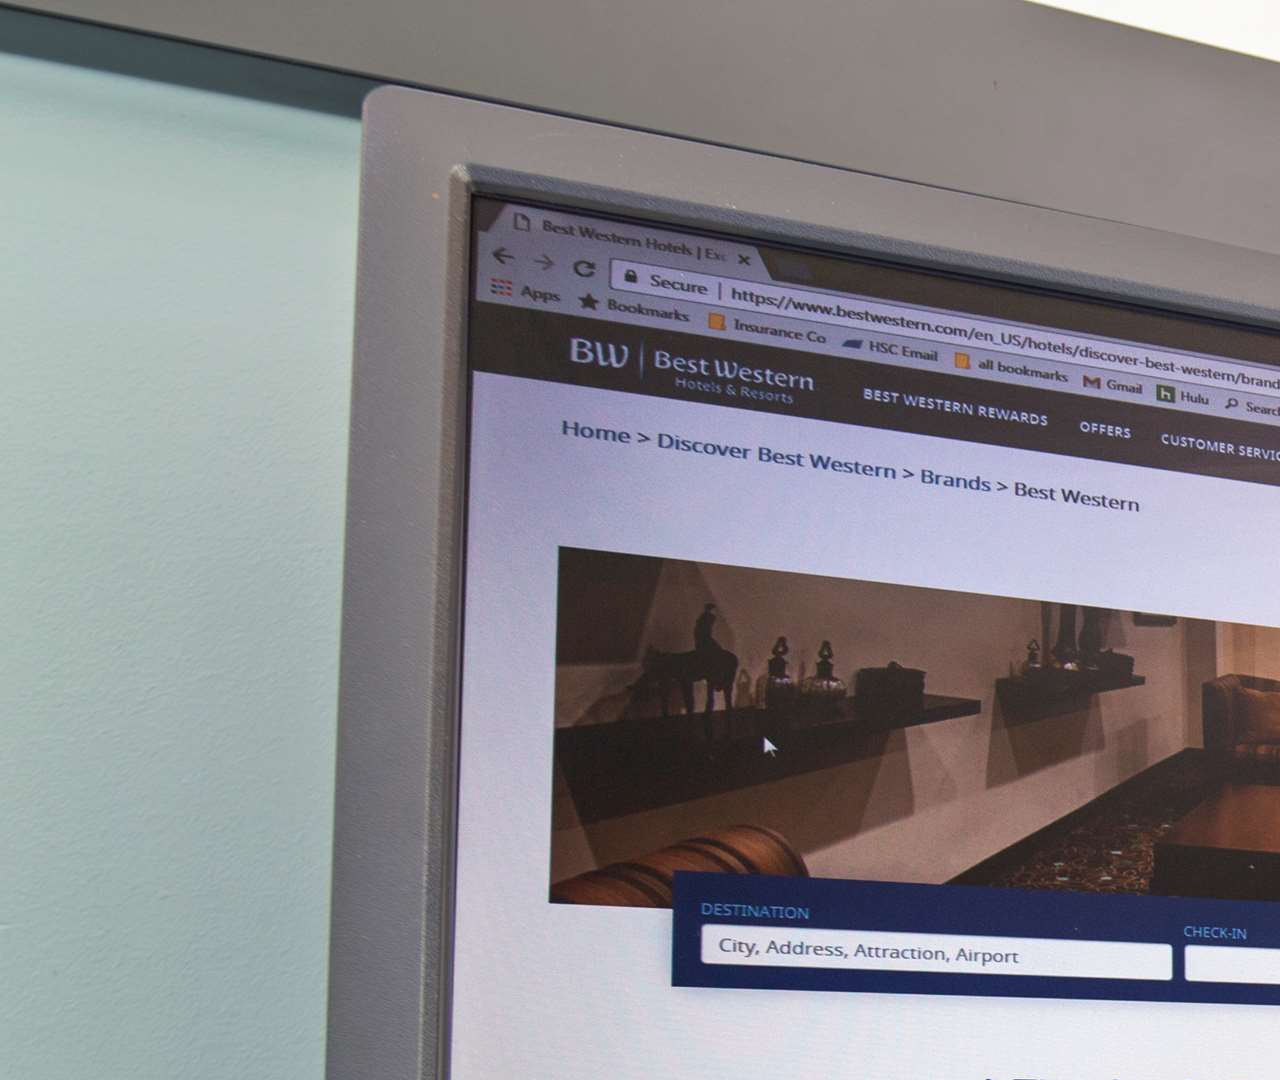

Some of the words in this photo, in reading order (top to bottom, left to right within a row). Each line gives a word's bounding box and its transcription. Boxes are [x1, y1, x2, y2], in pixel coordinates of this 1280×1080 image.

[543, 220, 576, 237] Best
[576, 225, 641, 248] Western
[646, 237, 692, 257] Hotels
[521, 285, 561, 303] Apps
[650, 274, 708, 296] Secure
[607, 298, 690, 322] Bookmarks
[733, 318, 803, 341] Insurance
[807, 331, 827, 345] Co
[570, 337, 630, 369] BW
[869, 340, 899, 356] HSC
[902, 346, 939, 363] Email
[654, 350, 710, 377] Best
[714, 360, 816, 391] Western
[978, 359, 994, 371] all
[997, 361, 1069, 383] bookmarks
[675, 375, 722, 395] Hotels
[726, 384, 737, 396] &
[740, 387, 795, 405] Resorts
[1107, 379, 1143, 396] Gmail
[1180, 390, 1210, 407] Hulu
[863, 388, 900, 404] BEST
[902, 394, 974, 416] WESTERN
[978, 405, 1048, 427] REWARDS
[1079, 420, 1132, 439] OFFERS
[1161, 433, 1235, 455] CUSTOMER
[562, 420, 631, 444] Home
[657, 433, 751, 460] Discover
[758, 447, 805, 467] Best
[809, 454, 896, 479] Western
[921, 469, 992, 492] Brands
[1014, 481, 1057, 501] Best
[1061, 488, 1140, 512] Western
[701, 902, 810, 920] DESTINATION
[1183, 925, 1248, 941] CHECK-IN
[718, 937, 761, 958] City,
[765, 939, 849, 960] Address,
[853, 944, 951, 964] Attraction,
[955, 947, 1020, 967] Airport
